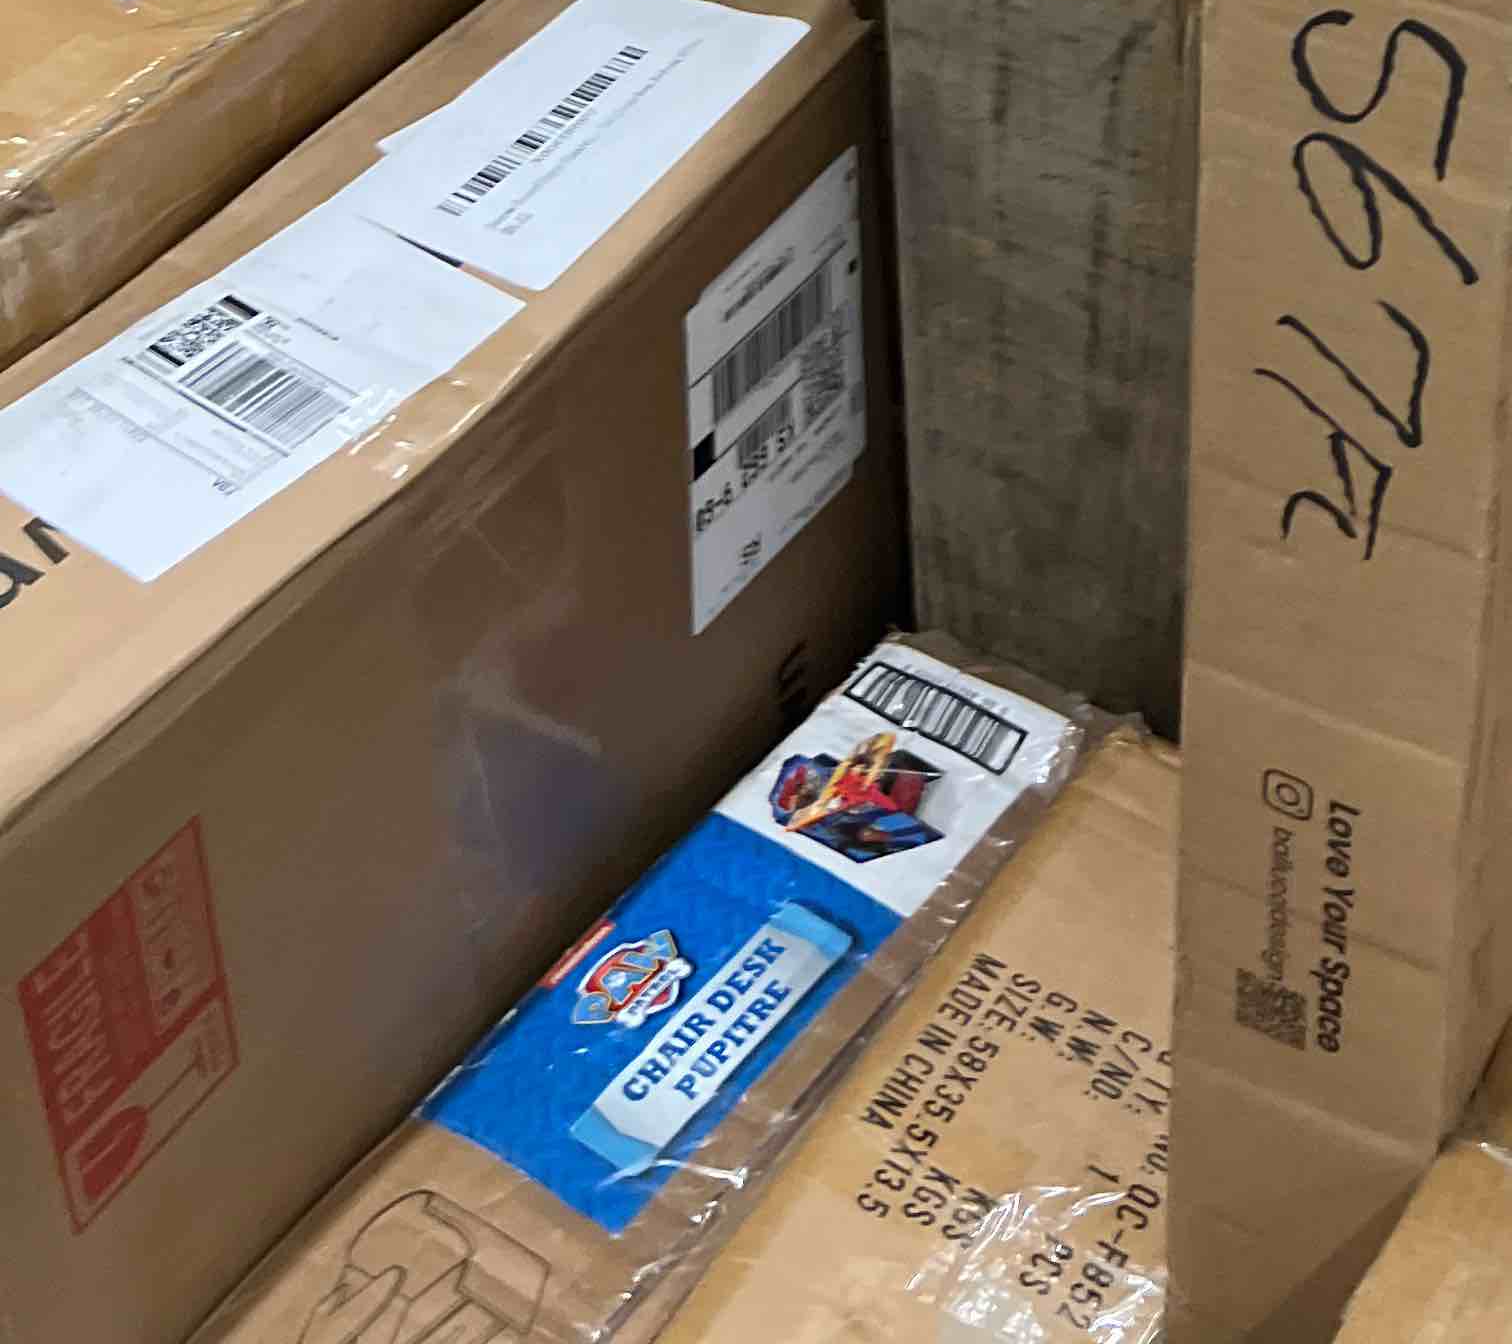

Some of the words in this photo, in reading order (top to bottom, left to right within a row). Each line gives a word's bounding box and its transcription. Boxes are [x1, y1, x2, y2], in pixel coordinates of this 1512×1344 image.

[1325, 800, 1361, 878] Love
[1321, 886, 1355, 955] Your
[573, 929, 679, 1024] PAW
[937, 952, 1008, 1027] MADE
[983, 973, 1041, 1033] SIZE:
[1310, 957, 1350, 1053] Space
[622, 1012, 716, 1101] CHAIR
[706, 938, 786, 1014] DESK
[674, 979, 790, 1100] PUPITRE
[917, 1023, 957, 1056] IN
[857, 1035, 1000, 1219] 58X35.5X13.5
[860, 1052, 934, 1130] CHINA
[904, 1166, 960, 1226] KGS
